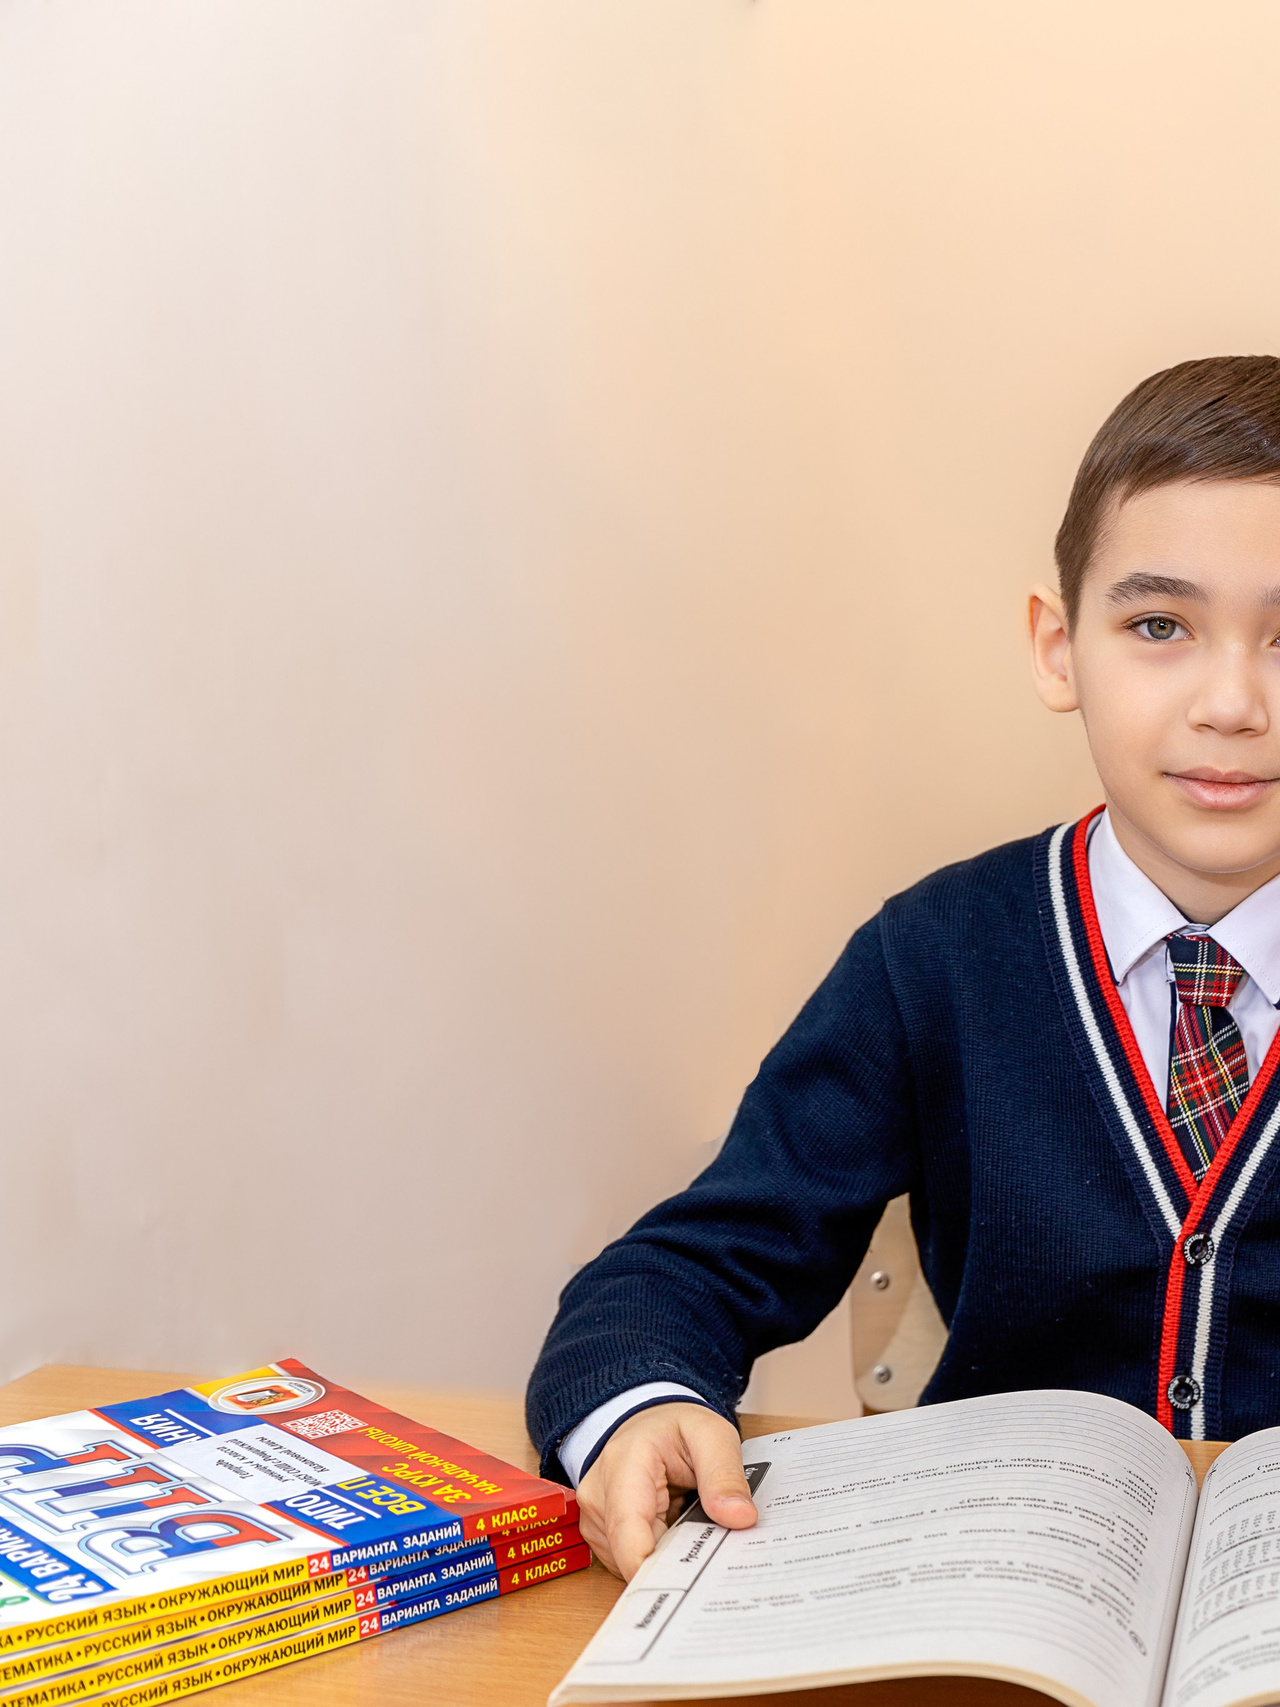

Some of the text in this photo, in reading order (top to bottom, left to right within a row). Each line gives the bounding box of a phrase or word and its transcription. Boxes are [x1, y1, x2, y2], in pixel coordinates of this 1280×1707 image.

[358, 1426, 503, 1494] НАЧАЛЬНОЙ ШКОЛЫ
[945, 1459, 1003, 1469] традиции
[842, 1477, 887, 1488] народа
[892, 1467, 939, 1478] любого
[916, 1466, 988, 1479] существуют
[1059, 1467, 1119, 1489] народные
[382, 1463, 471, 1503] ЗА КУРС
[356, 1486, 426, 1515] ВСЕ
[766, 1498, 802, 1508] крае?
[808, 1488, 856, 1500] родном
[944, 1503, 1017, 1511] проживают
[1023, 1503, 1072, 1515] народы
[1079, 1514, 1114, 1533] Какие
[26, 1609, 98, 1642] РУССКИЙ
[103, 1602, 147, 1624] ЯЗЫК
[159, 1570, 269, 1610] ОКРУЖАЮЩИЙ
[273, 1564, 304, 1582] МИР
[309, 1560, 329, 1573] 24
[333, 1543, 396, 1567] ВАРИАНТА
[403, 1522, 460, 1548] ЗАДАНИЙ
[476, 1519, 485, 1531] 4
[492, 1506, 537, 1528] КЛАСС
[35, 1573, 104, 1601] 24
[0, 1651, 73, 1680] ЕМАТИКА
[84, 1628, 152, 1658] РУССКИЙ
[156, 1615, 198, 1637] ЯЗЫК
[208, 1581, 311, 1622] ОКРУЖАЮЩИЙ
[314, 1574, 343, 1592] МИР
[348, 1568, 365, 1582] 24
[369, 1550, 429, 1575] ВАРИАНТА
[434, 1536, 487, 1556] ЗАДАНИЙ
[502, 1525, 510, 1536] 4
[97, 1658, 164, 1687] РУССКИЙ
[167, 1643, 208, 1665] ЯЗЫК
[218, 1610, 321, 1650] ОКРУЖАЮЩИЙ
[323, 1599, 352, 1618] МИР
[356, 1593, 375, 1608] 24
[377, 1573, 436, 1599] ВАРИАНТА
[441, 1553, 494, 1580] ЗАДАНИЙ
[507, 1548, 515, 1559] 4
[522, 1533, 562, 1554] КЛАСС
[172, 1670, 213, 1692] ЯЗЫК
[222, 1635, 325, 1677] ОКРУЖАЮЩИЙ
[326, 1625, 356, 1640] МИР
[361, 1620, 378, 1634] 24
[382, 1599, 440, 1627] ВАРИАНТА
[446, 1580, 498, 1605] ЗАДАНИЙ
[511, 1574, 519, 1584] 4
[525, 1559, 566, 1580] КЛАСС
